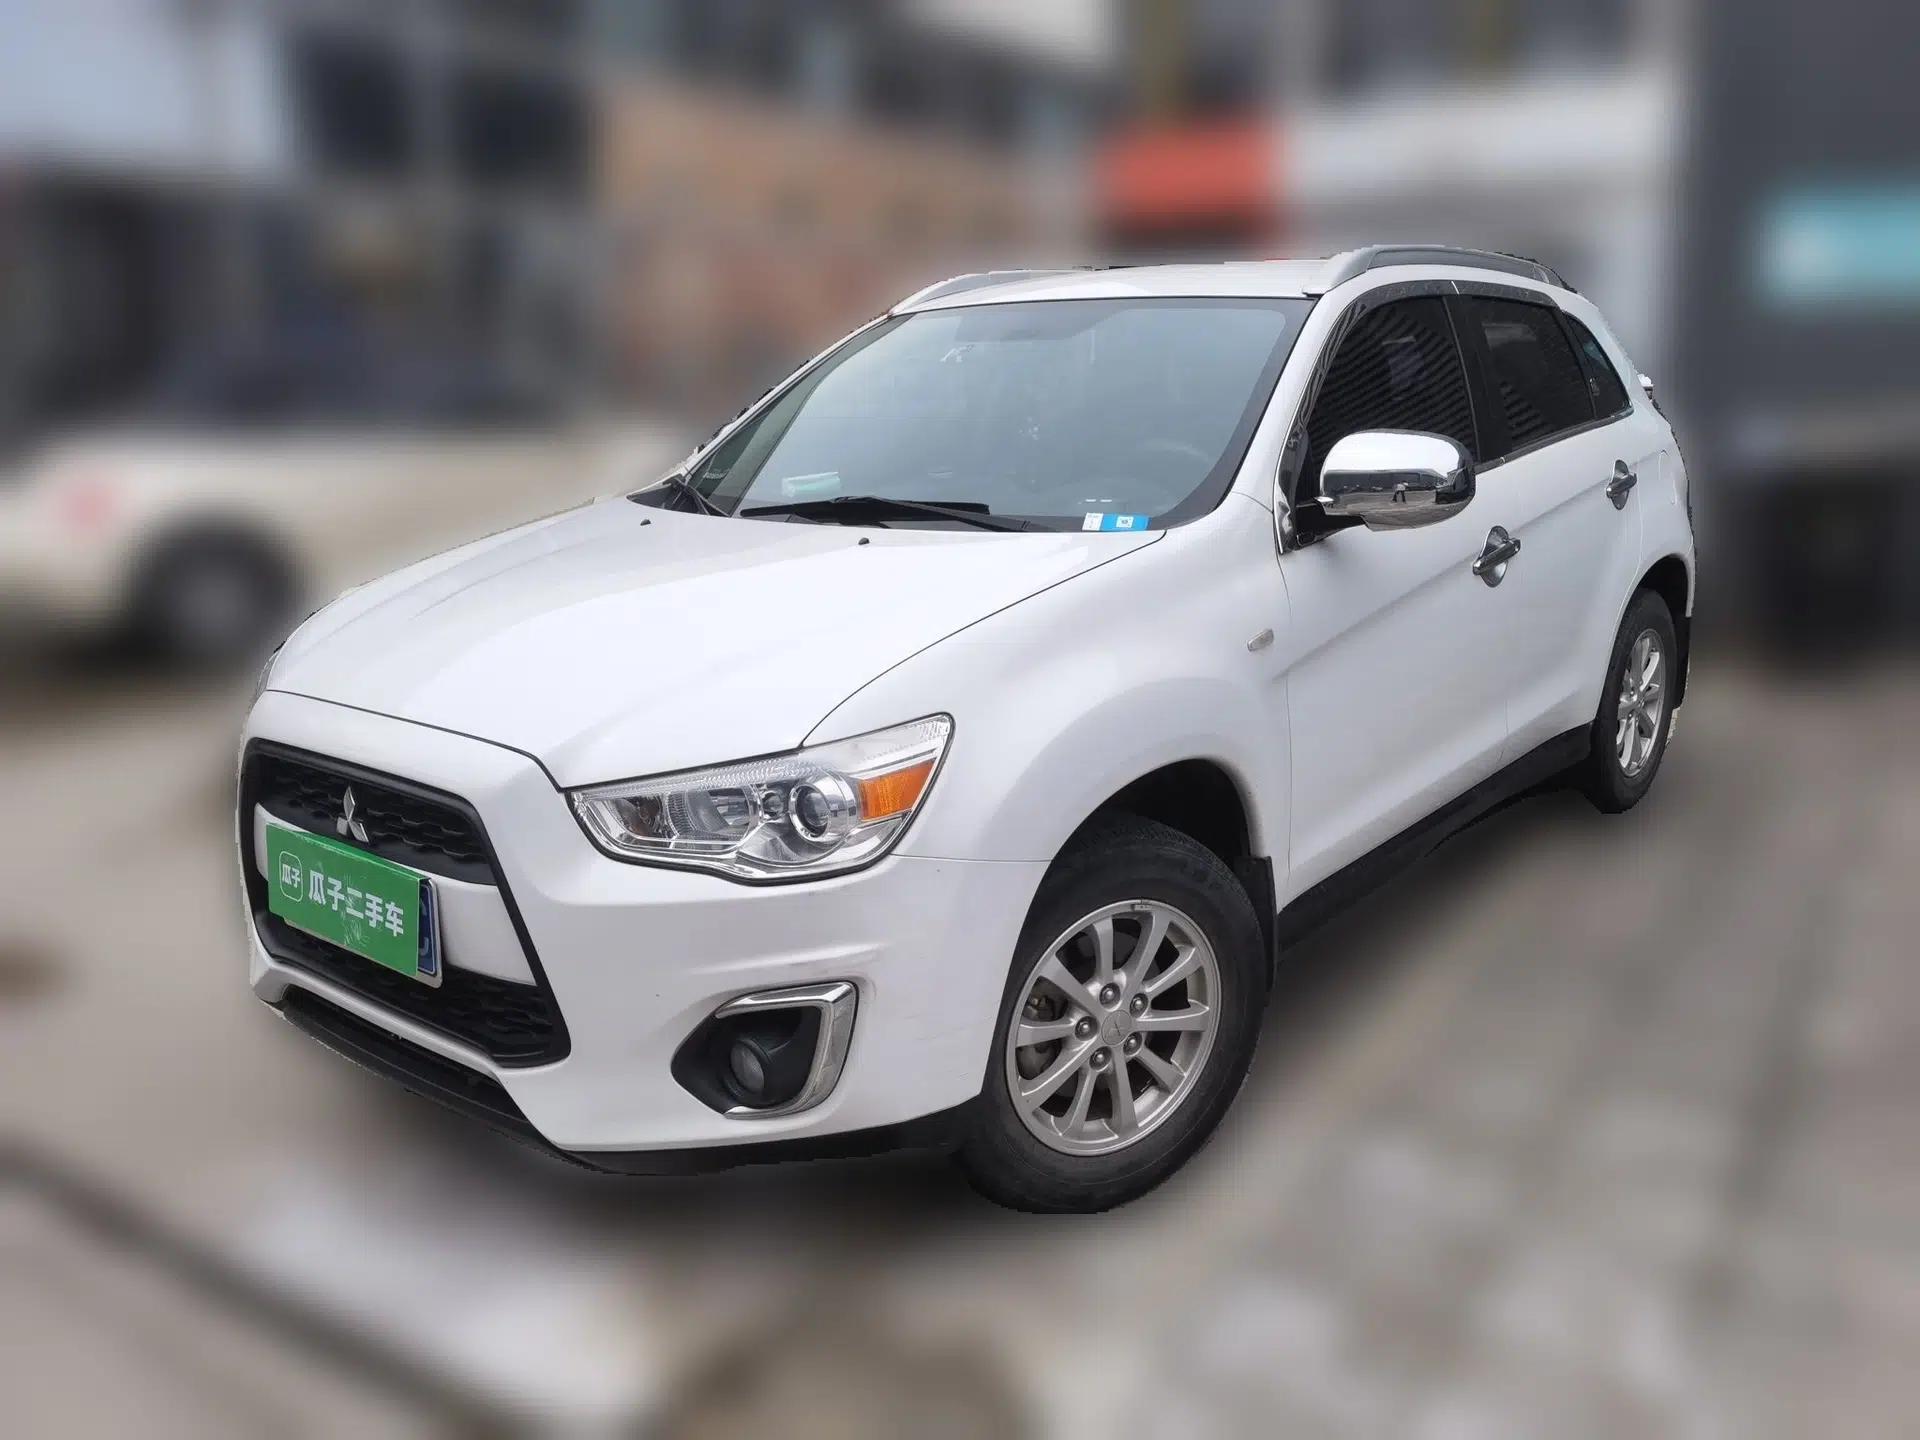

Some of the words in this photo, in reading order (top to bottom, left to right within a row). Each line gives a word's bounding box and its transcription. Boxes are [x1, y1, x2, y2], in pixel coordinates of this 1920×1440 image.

[282, 863, 301, 888] 瓜子
[308, 869, 404, 937] 瓜子二手车
